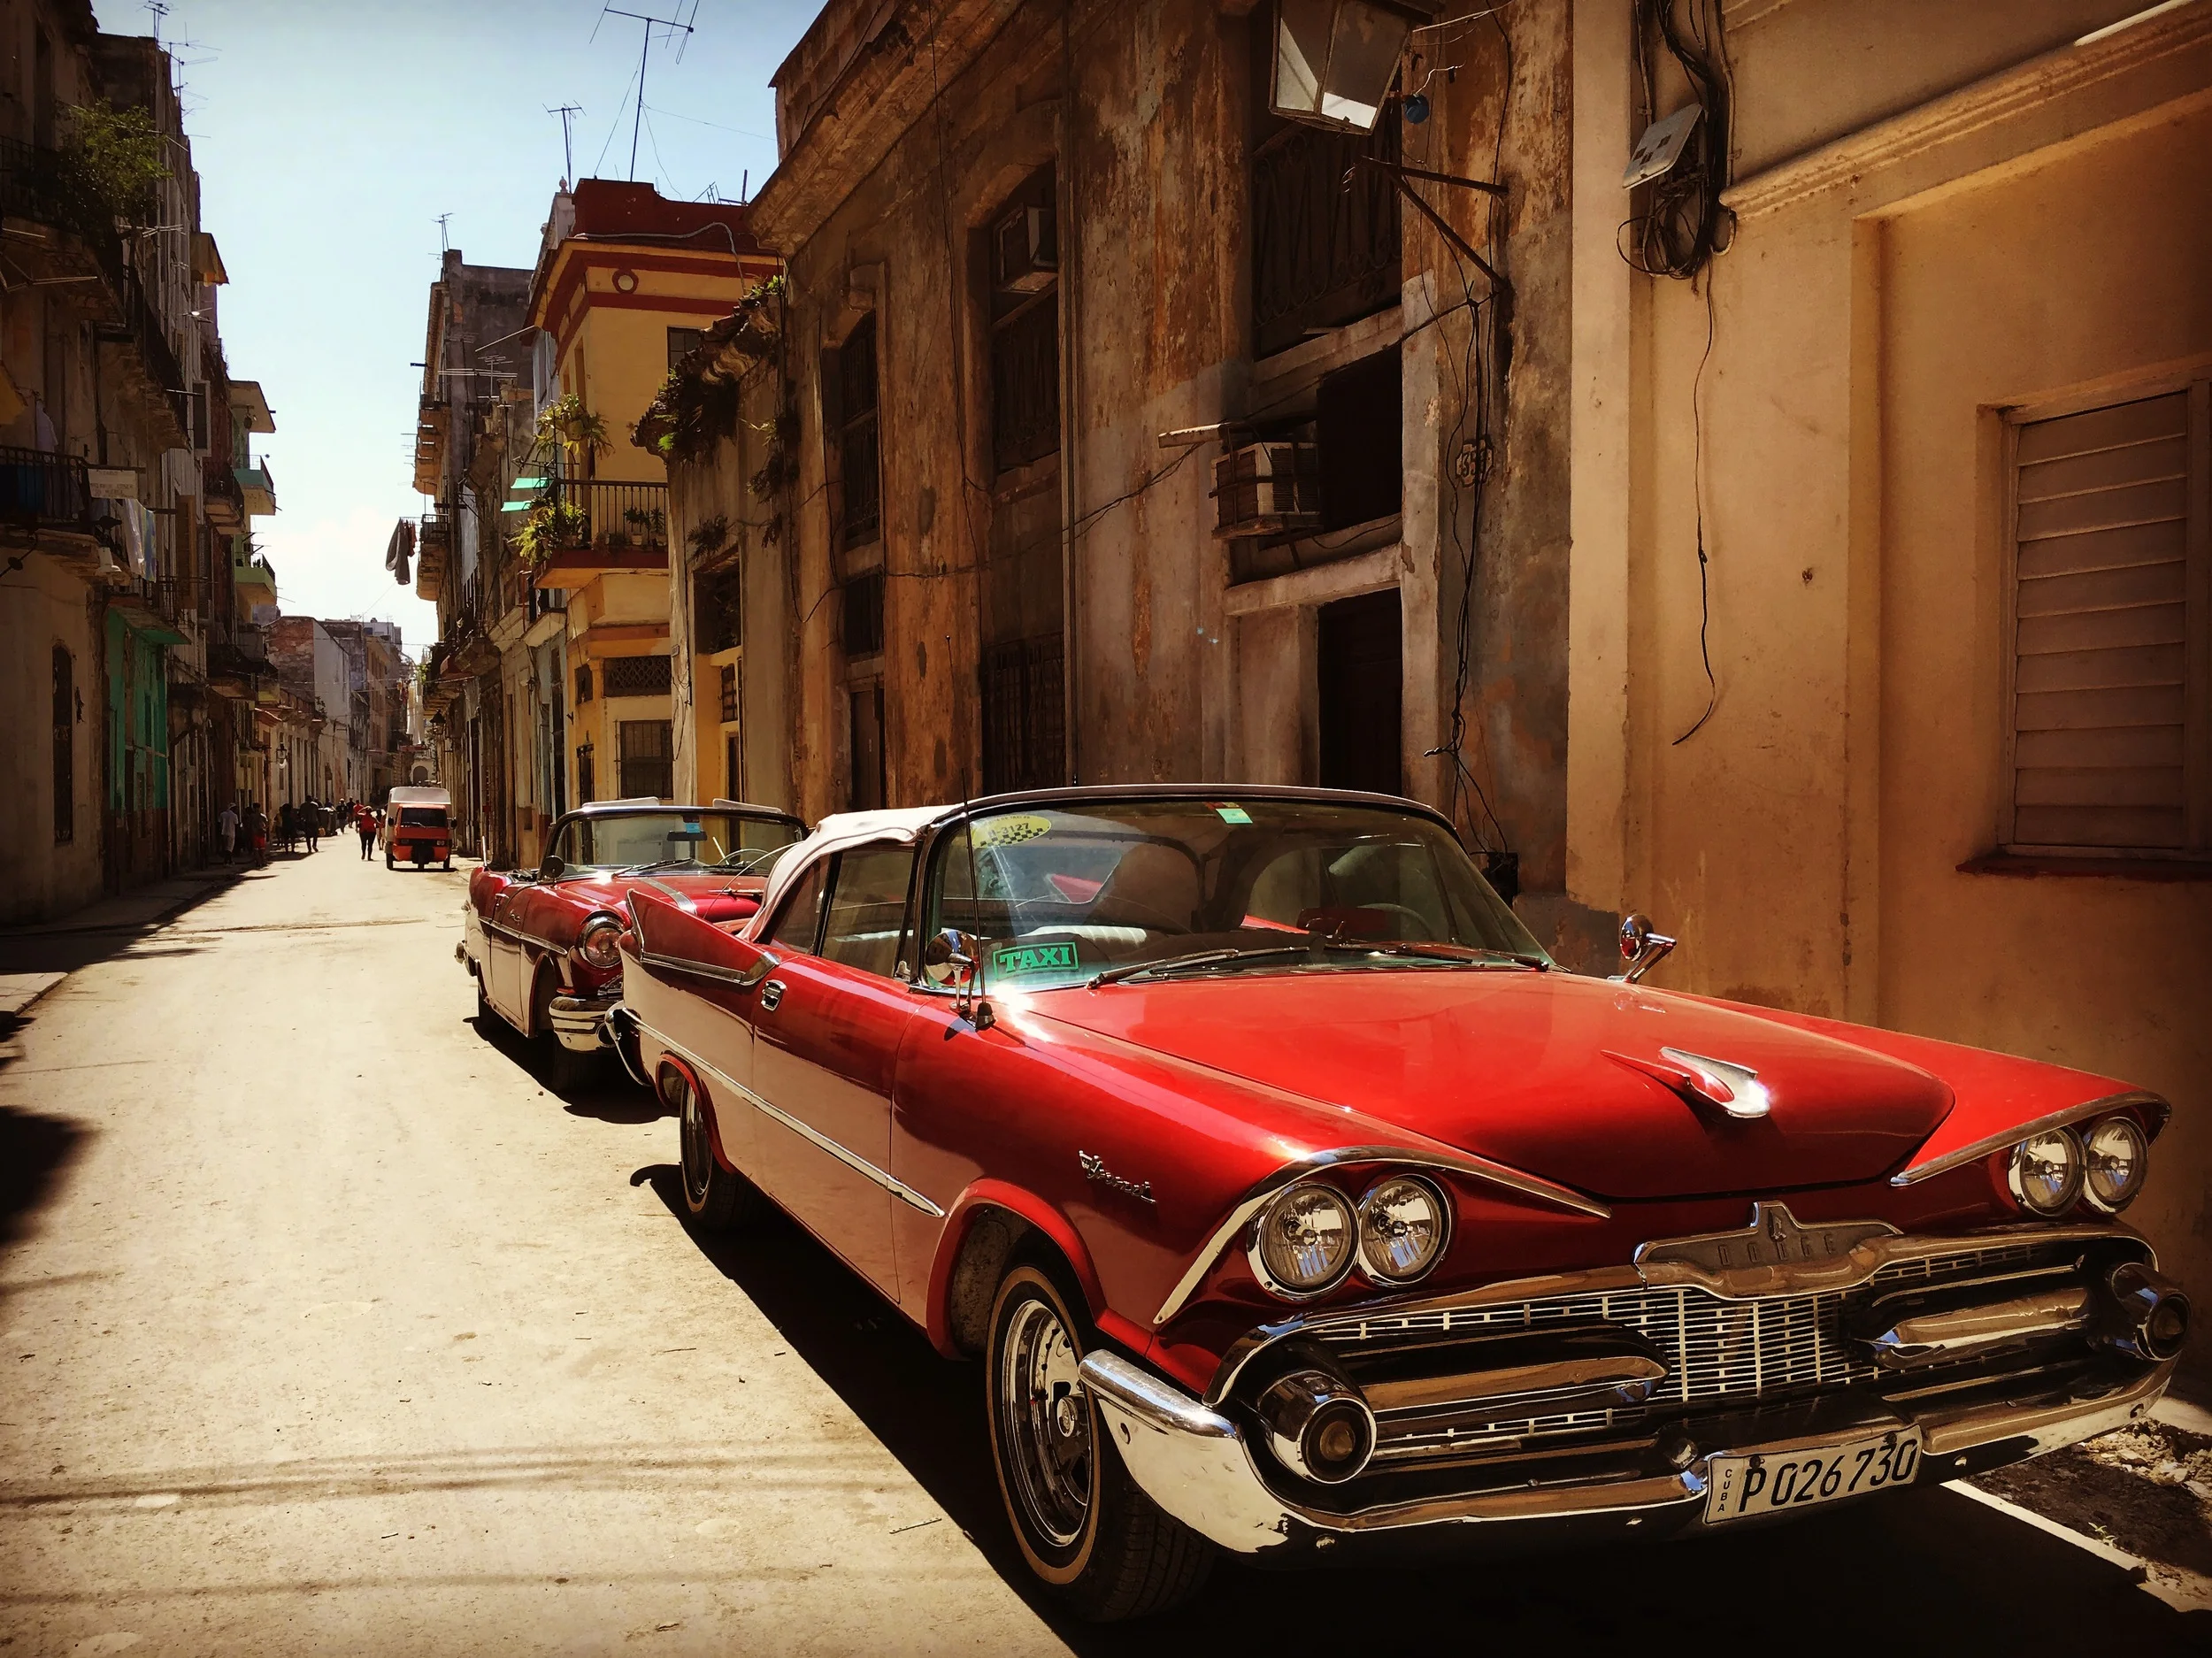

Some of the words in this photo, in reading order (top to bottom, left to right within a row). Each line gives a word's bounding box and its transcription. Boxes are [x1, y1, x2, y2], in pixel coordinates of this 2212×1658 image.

[999, 947, 1071, 972] TAXI
[1717, 1233, 1836, 1267] DODGE
[1717, 1468, 1732, 1512] CUBA
